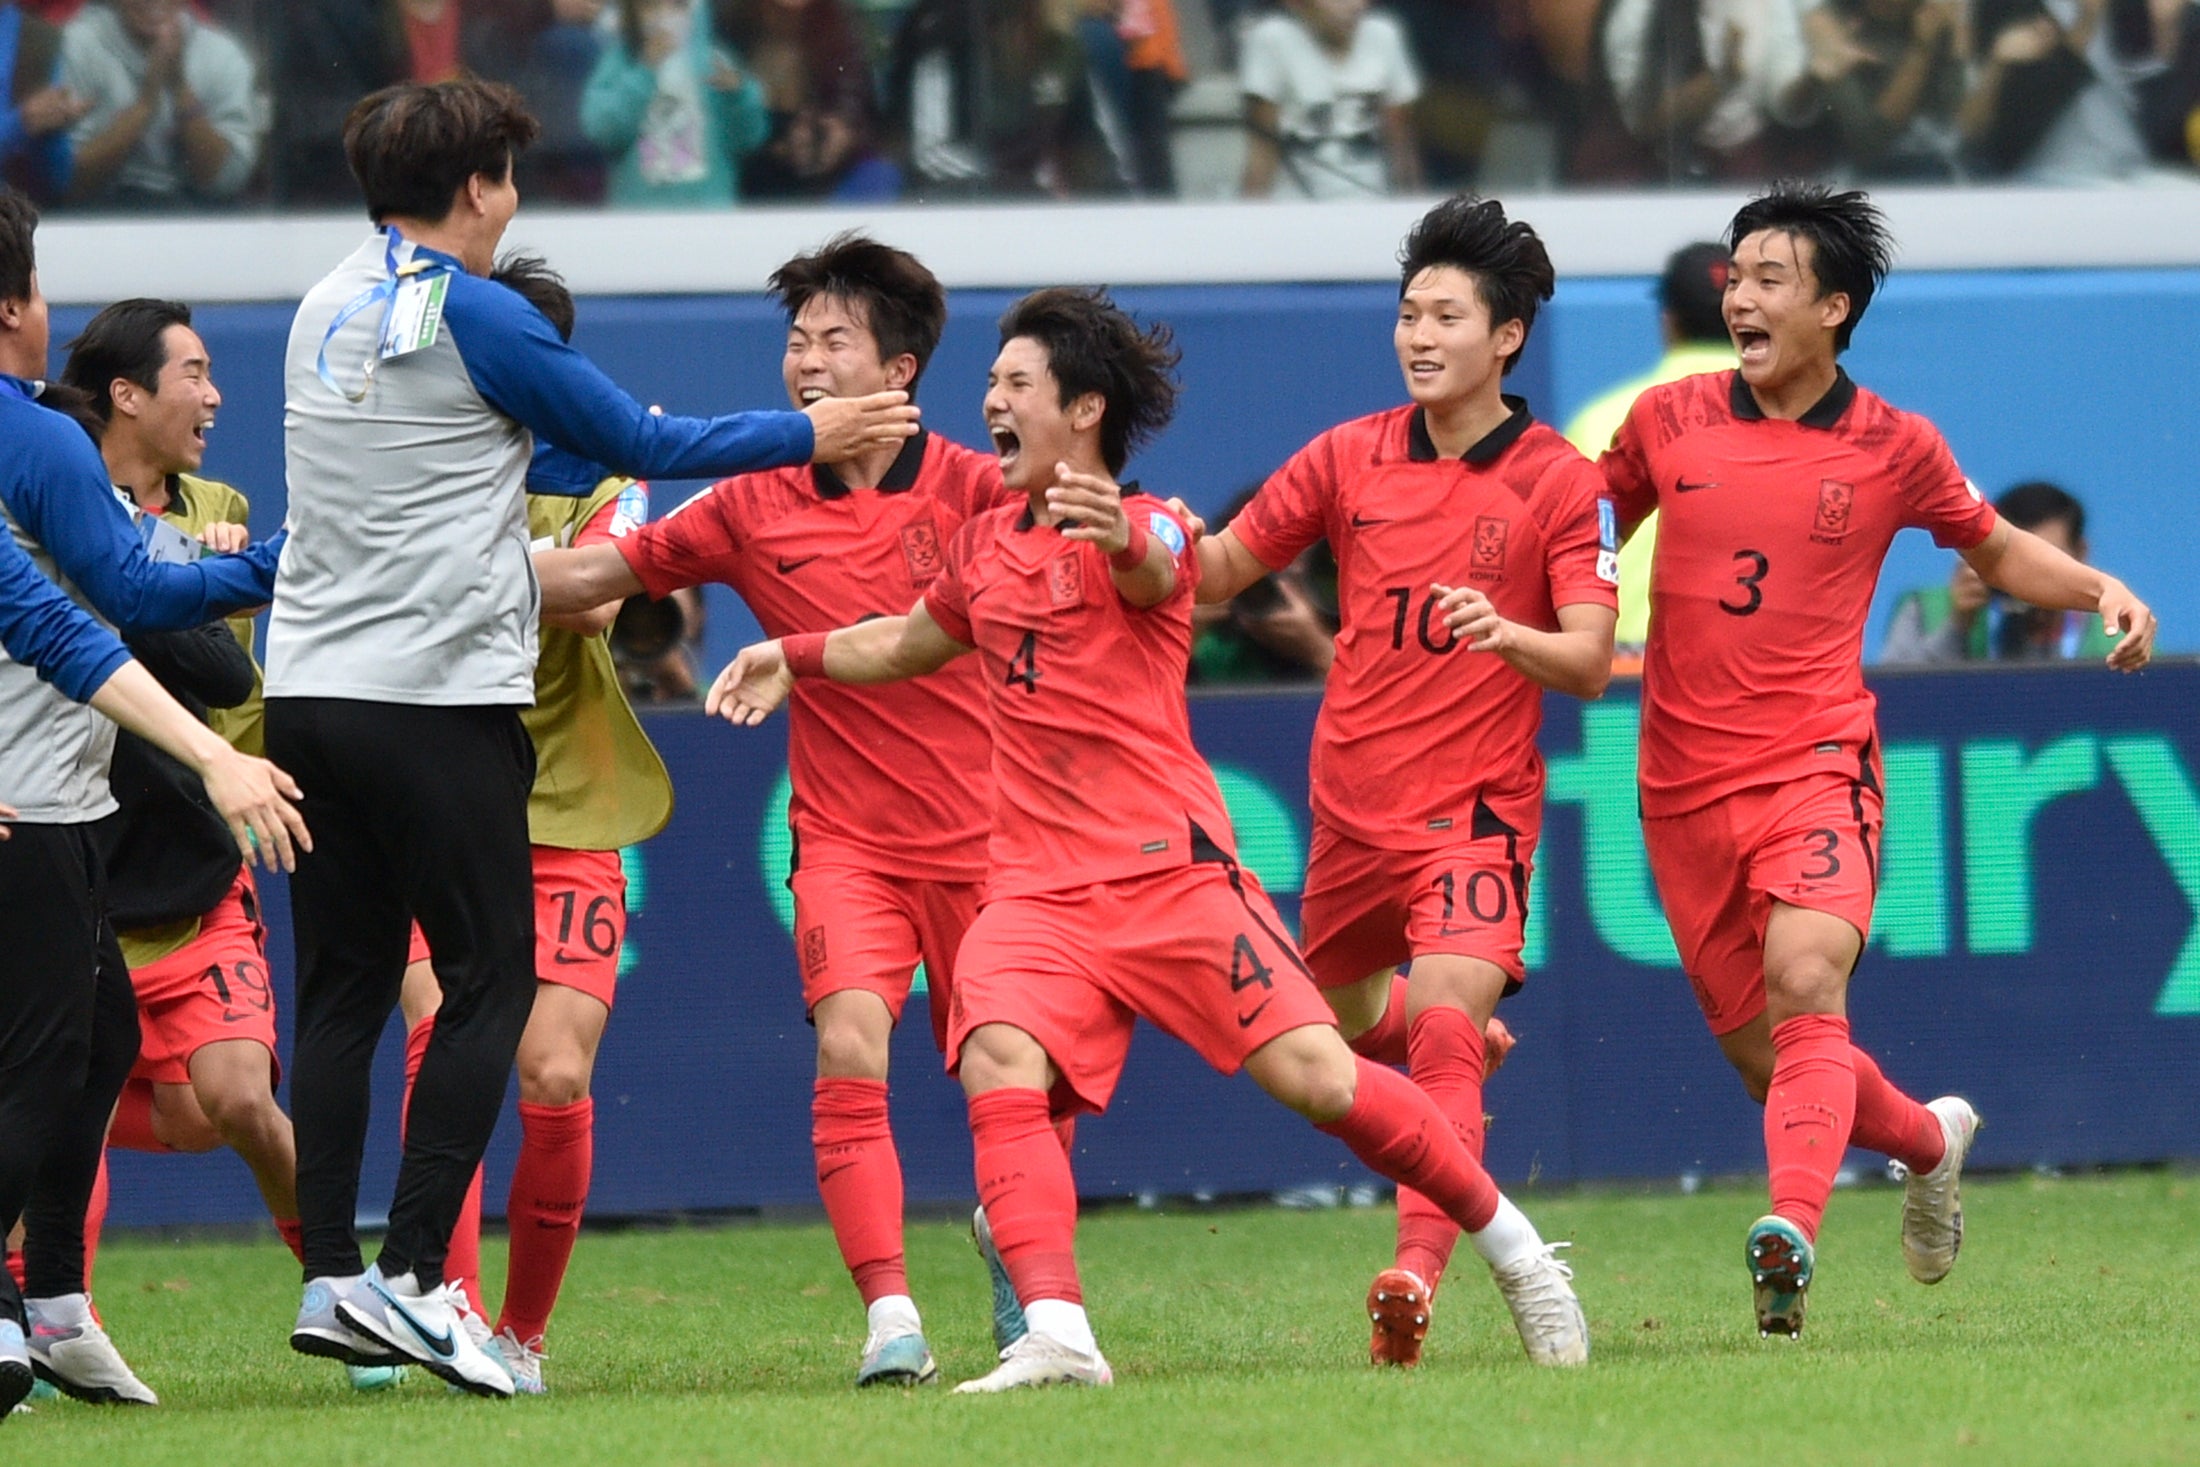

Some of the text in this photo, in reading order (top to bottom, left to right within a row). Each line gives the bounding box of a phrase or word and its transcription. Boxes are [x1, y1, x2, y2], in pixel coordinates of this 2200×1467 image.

[1719, 549, 1769, 616] 3
[1386, 587, 1460, 655] 10
[1005, 629, 1043, 694] 4
[1801, 828, 1840, 879] 3
[550, 890, 616, 957] 16
[1431, 870, 1508, 923] 10
[199, 961, 271, 1012] 19
[1231, 932, 1273, 993] 4
